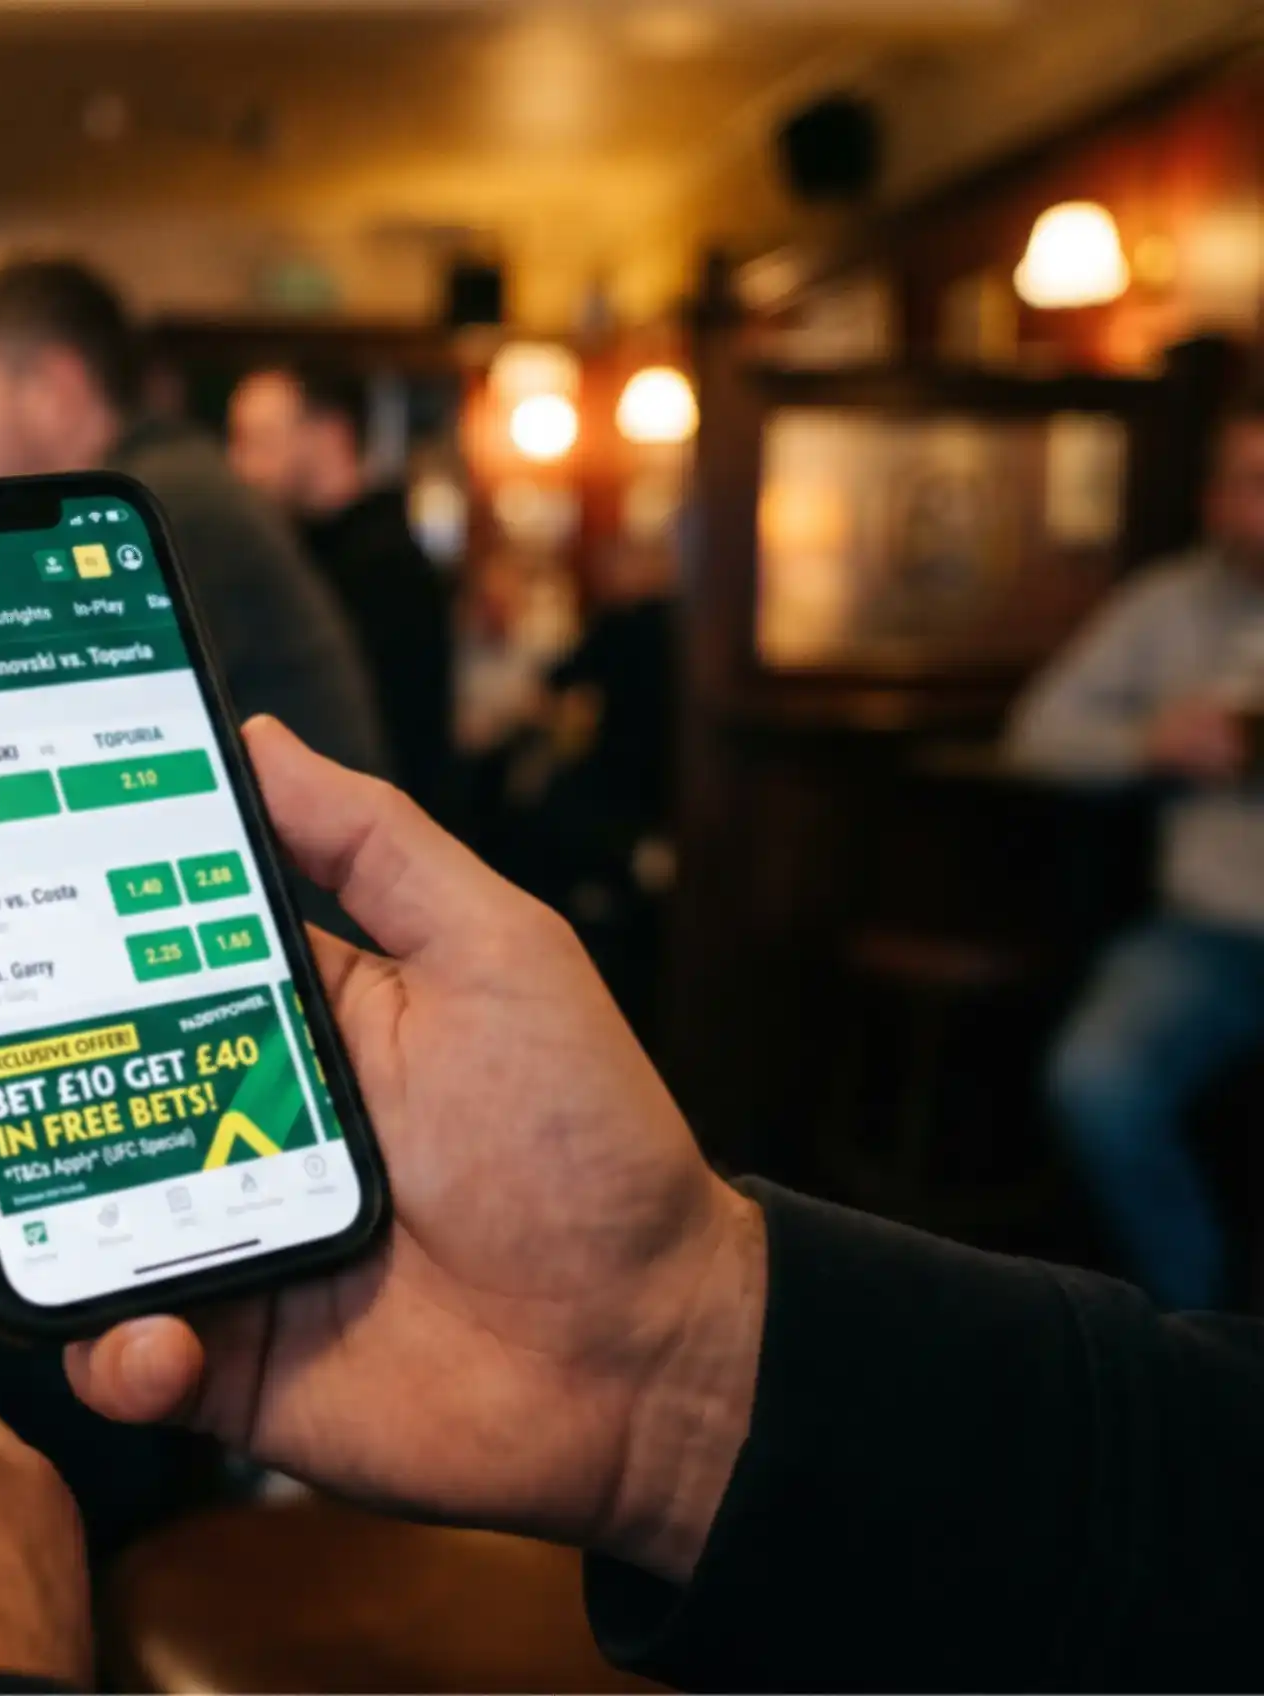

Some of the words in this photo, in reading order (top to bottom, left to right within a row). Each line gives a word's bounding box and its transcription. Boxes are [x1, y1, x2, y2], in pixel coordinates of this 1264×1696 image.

[73, 598, 124, 617] In-Play
[59, 652, 86, 669] vs.
[87, 642, 154, 667] Topuria
[93, 726, 164, 749] TOPURIA
[120, 768, 158, 790] 2.10
[31, 884, 78, 904] Costa
[10, 961, 54, 980] Garry
[75, 1029, 132, 1054] OFFER!
[58, 1065, 116, 1105] £10
[124, 1050, 185, 1089] GET
[196, 1035, 259, 1076] £40
[43, 1101, 124, 1147] FREE
[128, 1082, 218, 1128] BETS!
[103, 1142, 138, 1167] (UFC
